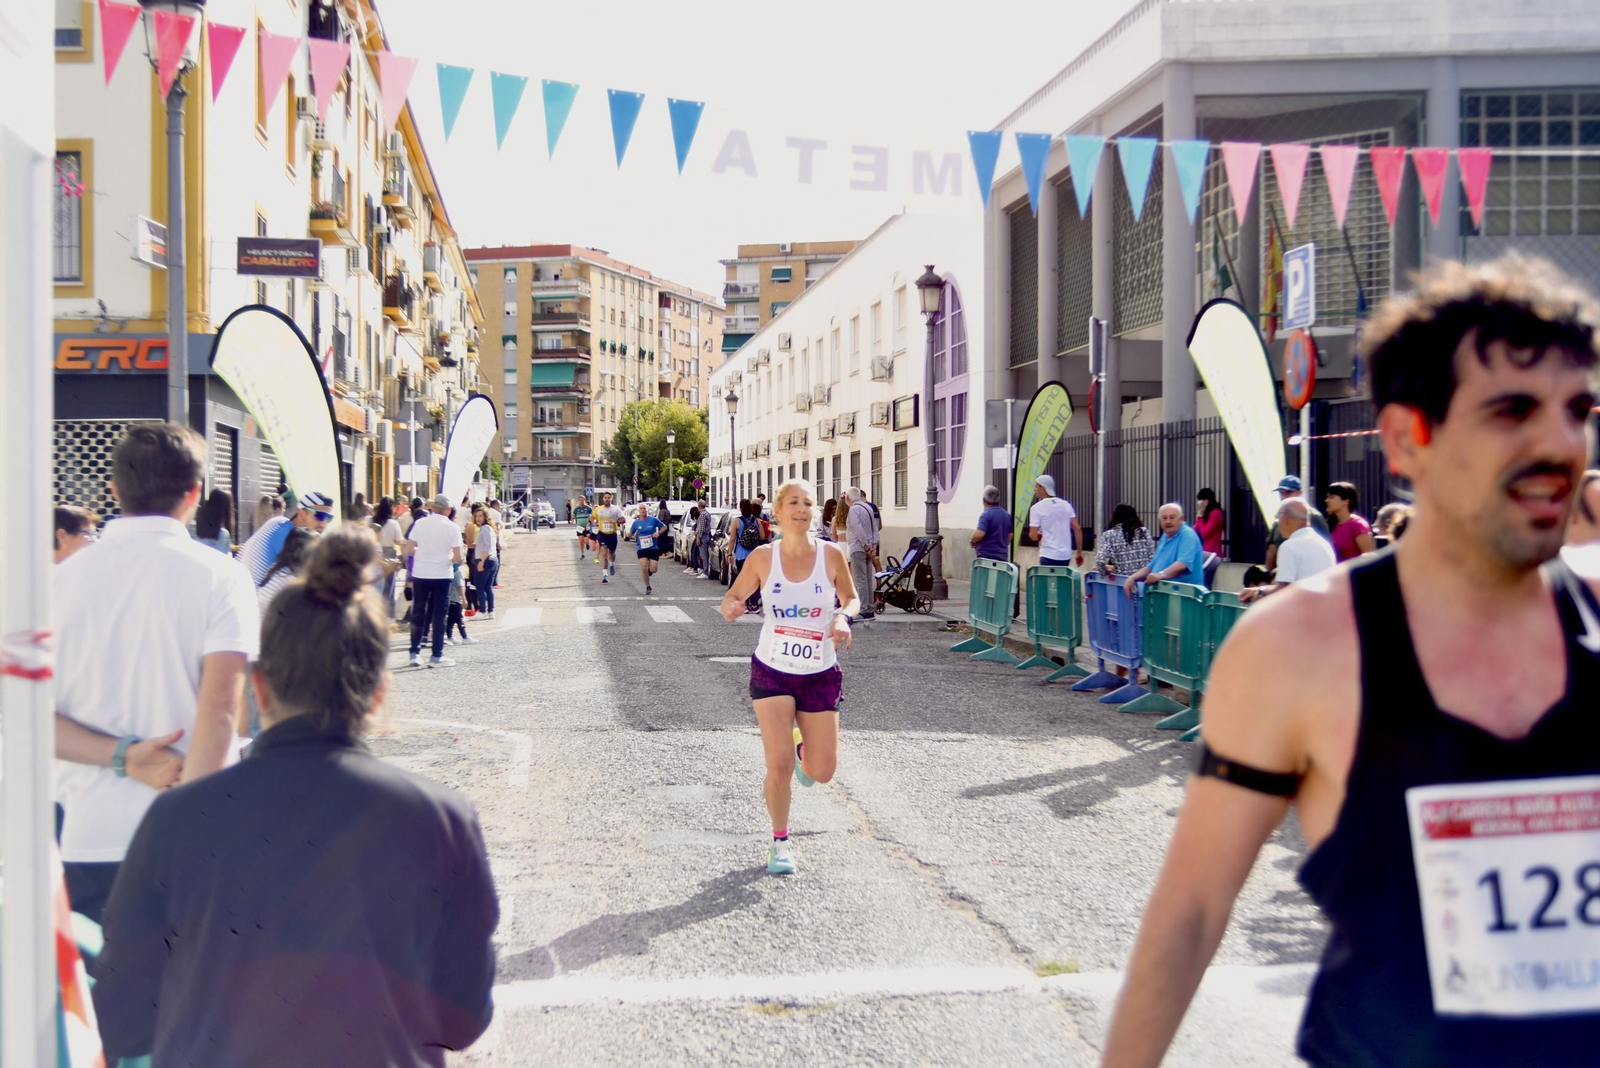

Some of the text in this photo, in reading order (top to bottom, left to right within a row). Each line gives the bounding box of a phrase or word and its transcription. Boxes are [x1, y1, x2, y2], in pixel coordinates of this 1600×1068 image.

[239, 255, 318, 268] CABALLERO
[55, 338, 169, 370] ERO
[772, 604, 822, 618] indea
[781, 641, 813, 659] 100
[1477, 861, 1600, 934] 128
